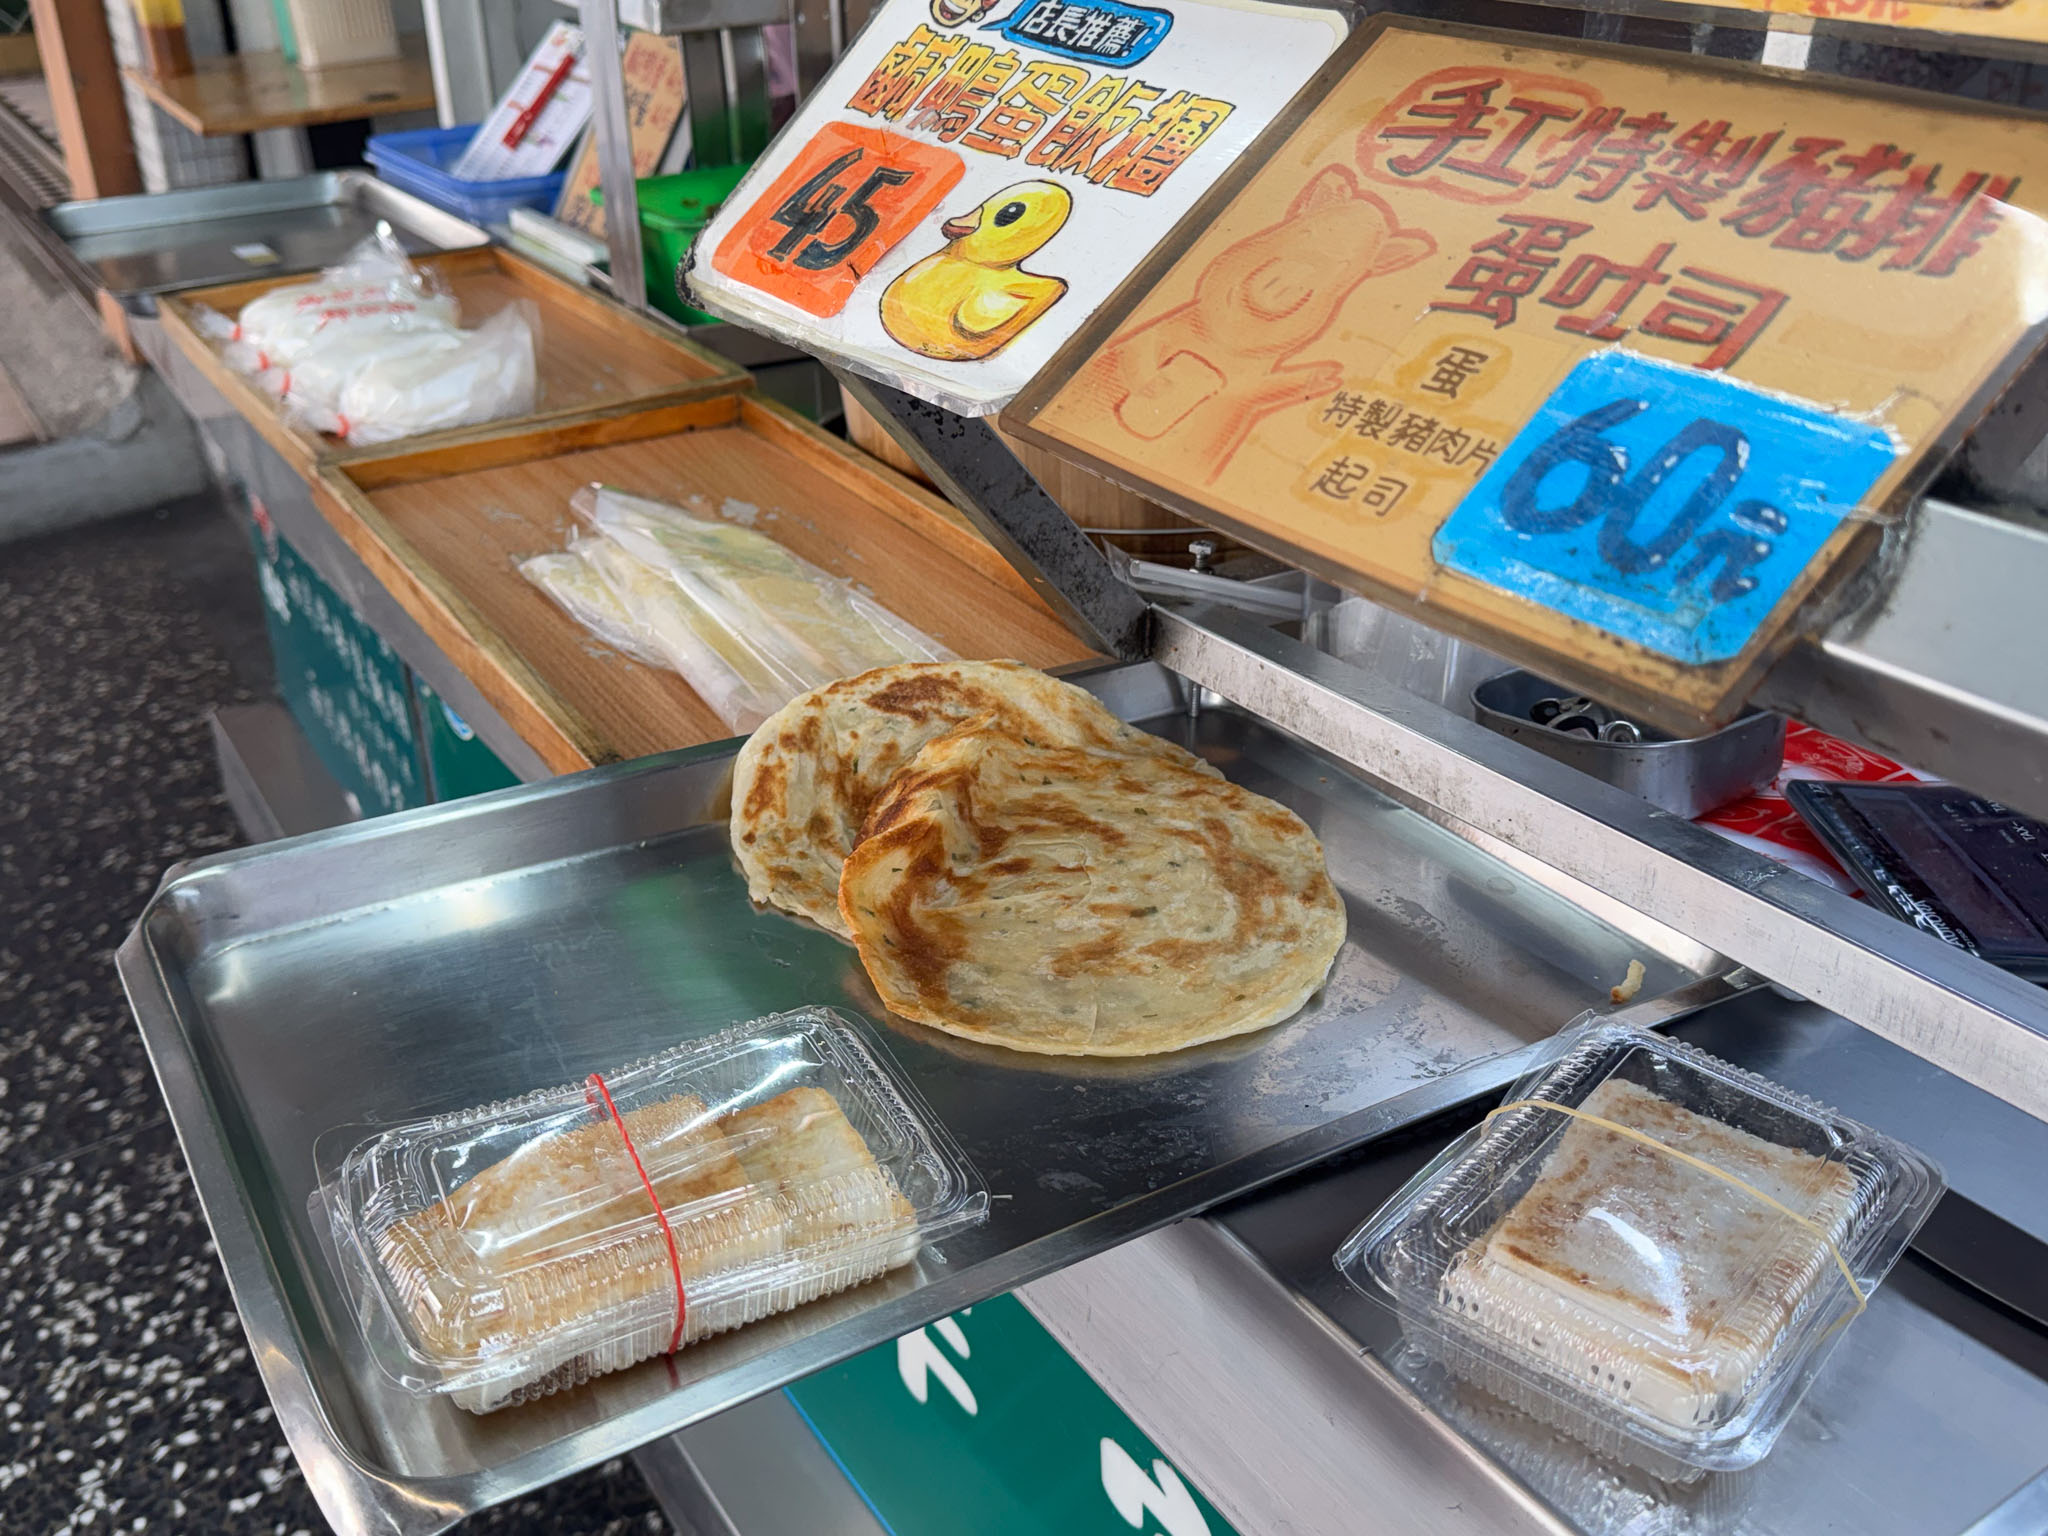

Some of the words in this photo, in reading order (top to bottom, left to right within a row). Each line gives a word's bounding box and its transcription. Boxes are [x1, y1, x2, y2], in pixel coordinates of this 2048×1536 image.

[767, 147, 915, 270] 45
[1379, 78, 2021, 277] 手工特製豬排
[1429, 213, 1790, 371] 蛋吐司
[1420, 346, 1489, 399] 蛋
[1309, 456, 1408, 516] 起司
[1322, 391, 1499, 477] 特製豬肉片
